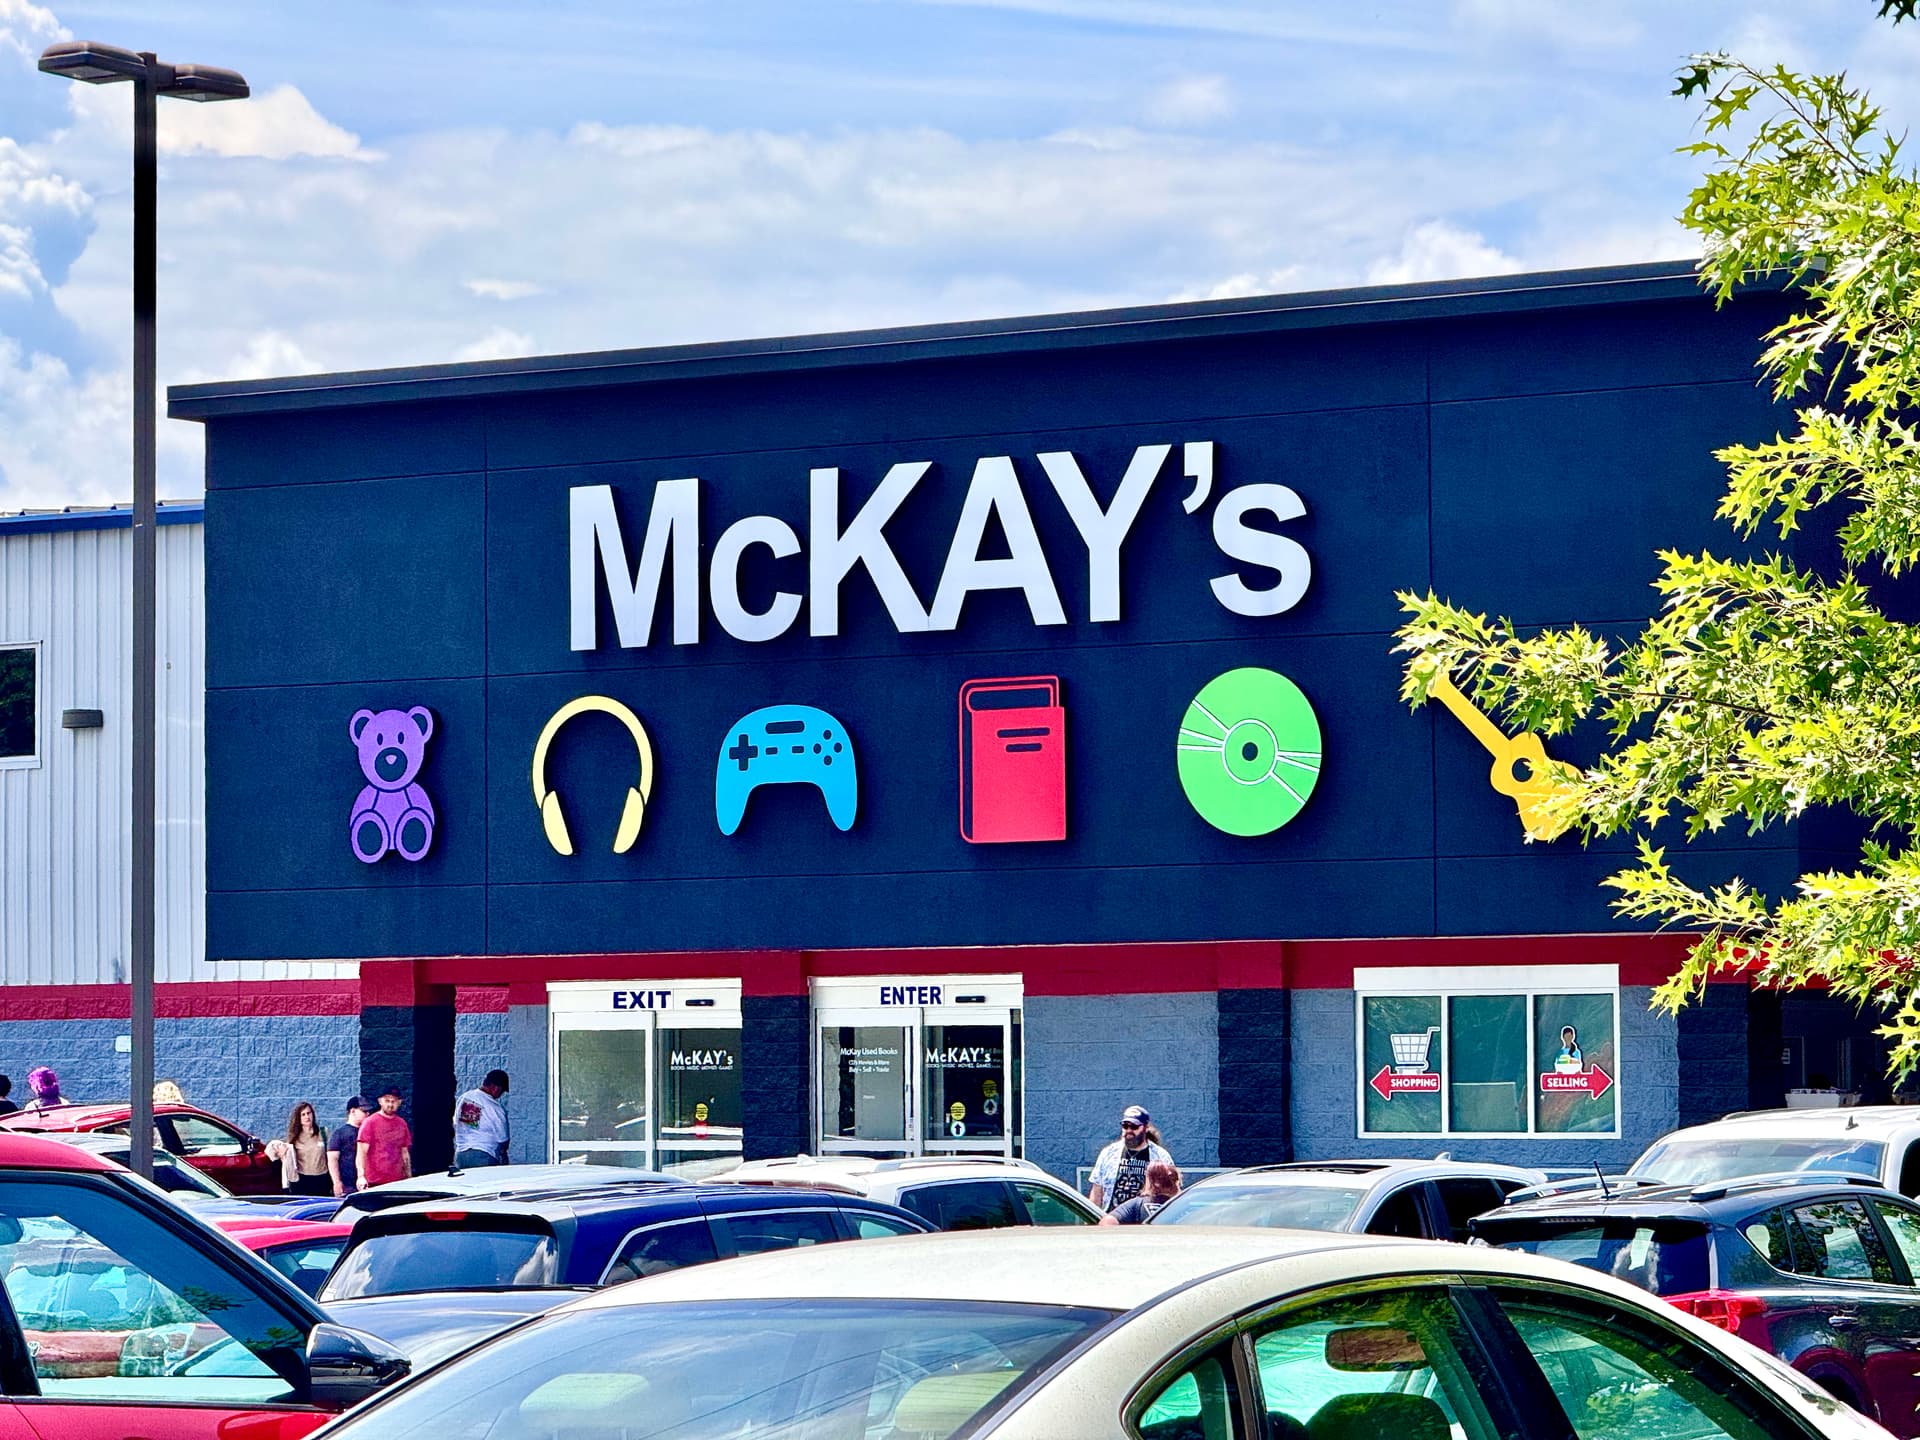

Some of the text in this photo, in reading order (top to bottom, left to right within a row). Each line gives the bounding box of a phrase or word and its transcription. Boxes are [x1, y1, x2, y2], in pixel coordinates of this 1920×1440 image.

[570, 441, 1312, 651] McKAY's
[613, 991, 672, 1009] EXIT
[880, 986, 942, 1005] ENTER
[671, 1050, 734, 1065] McKAY's
[840, 1048, 861, 1057] McKay
[926, 1047, 992, 1063] McKAY's
[1390, 1078, 1437, 1087] SHOPPING
[1547, 1078, 1588, 1088] SELLING
